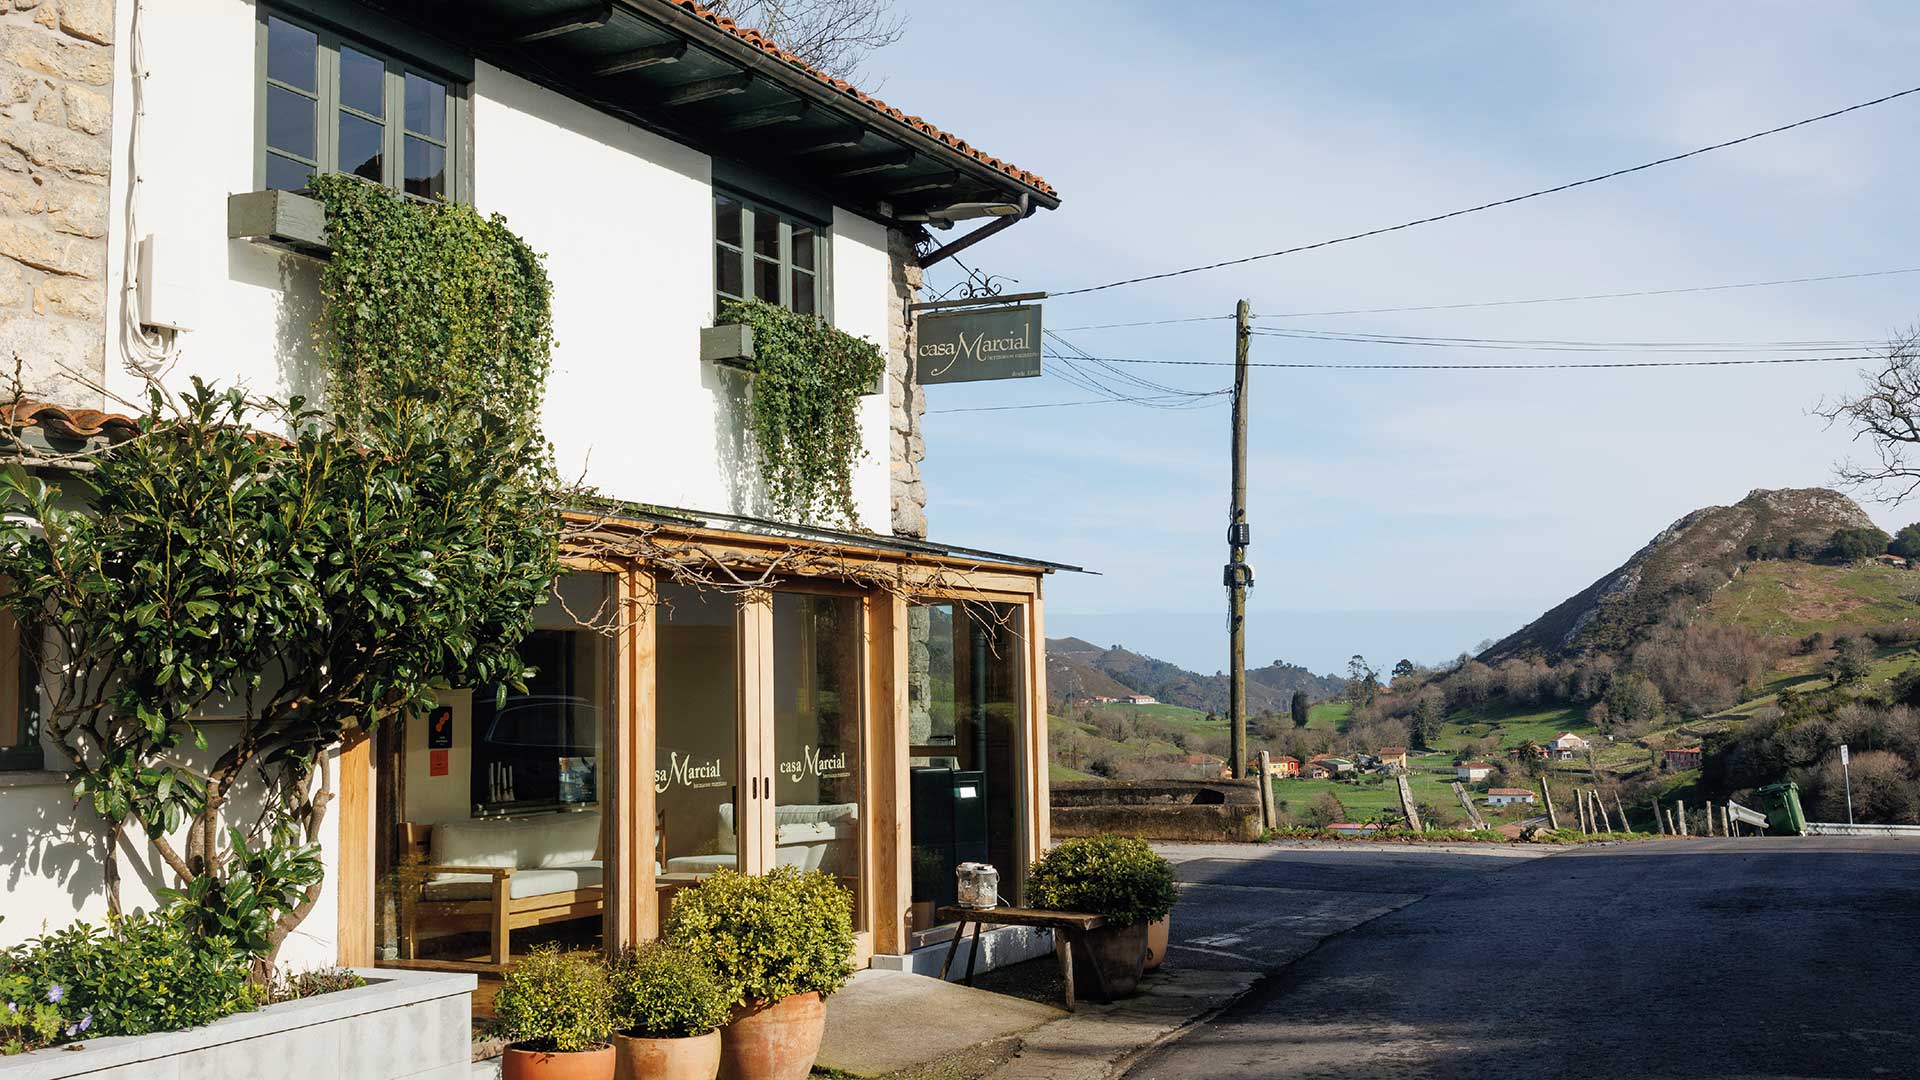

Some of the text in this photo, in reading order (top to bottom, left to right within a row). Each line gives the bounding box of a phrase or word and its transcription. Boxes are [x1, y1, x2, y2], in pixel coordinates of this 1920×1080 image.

[919, 322, 1030, 377] casa Marcial
[655, 751, 721, 794] sa Marcial
[780, 744, 845, 783] casa Marcial
